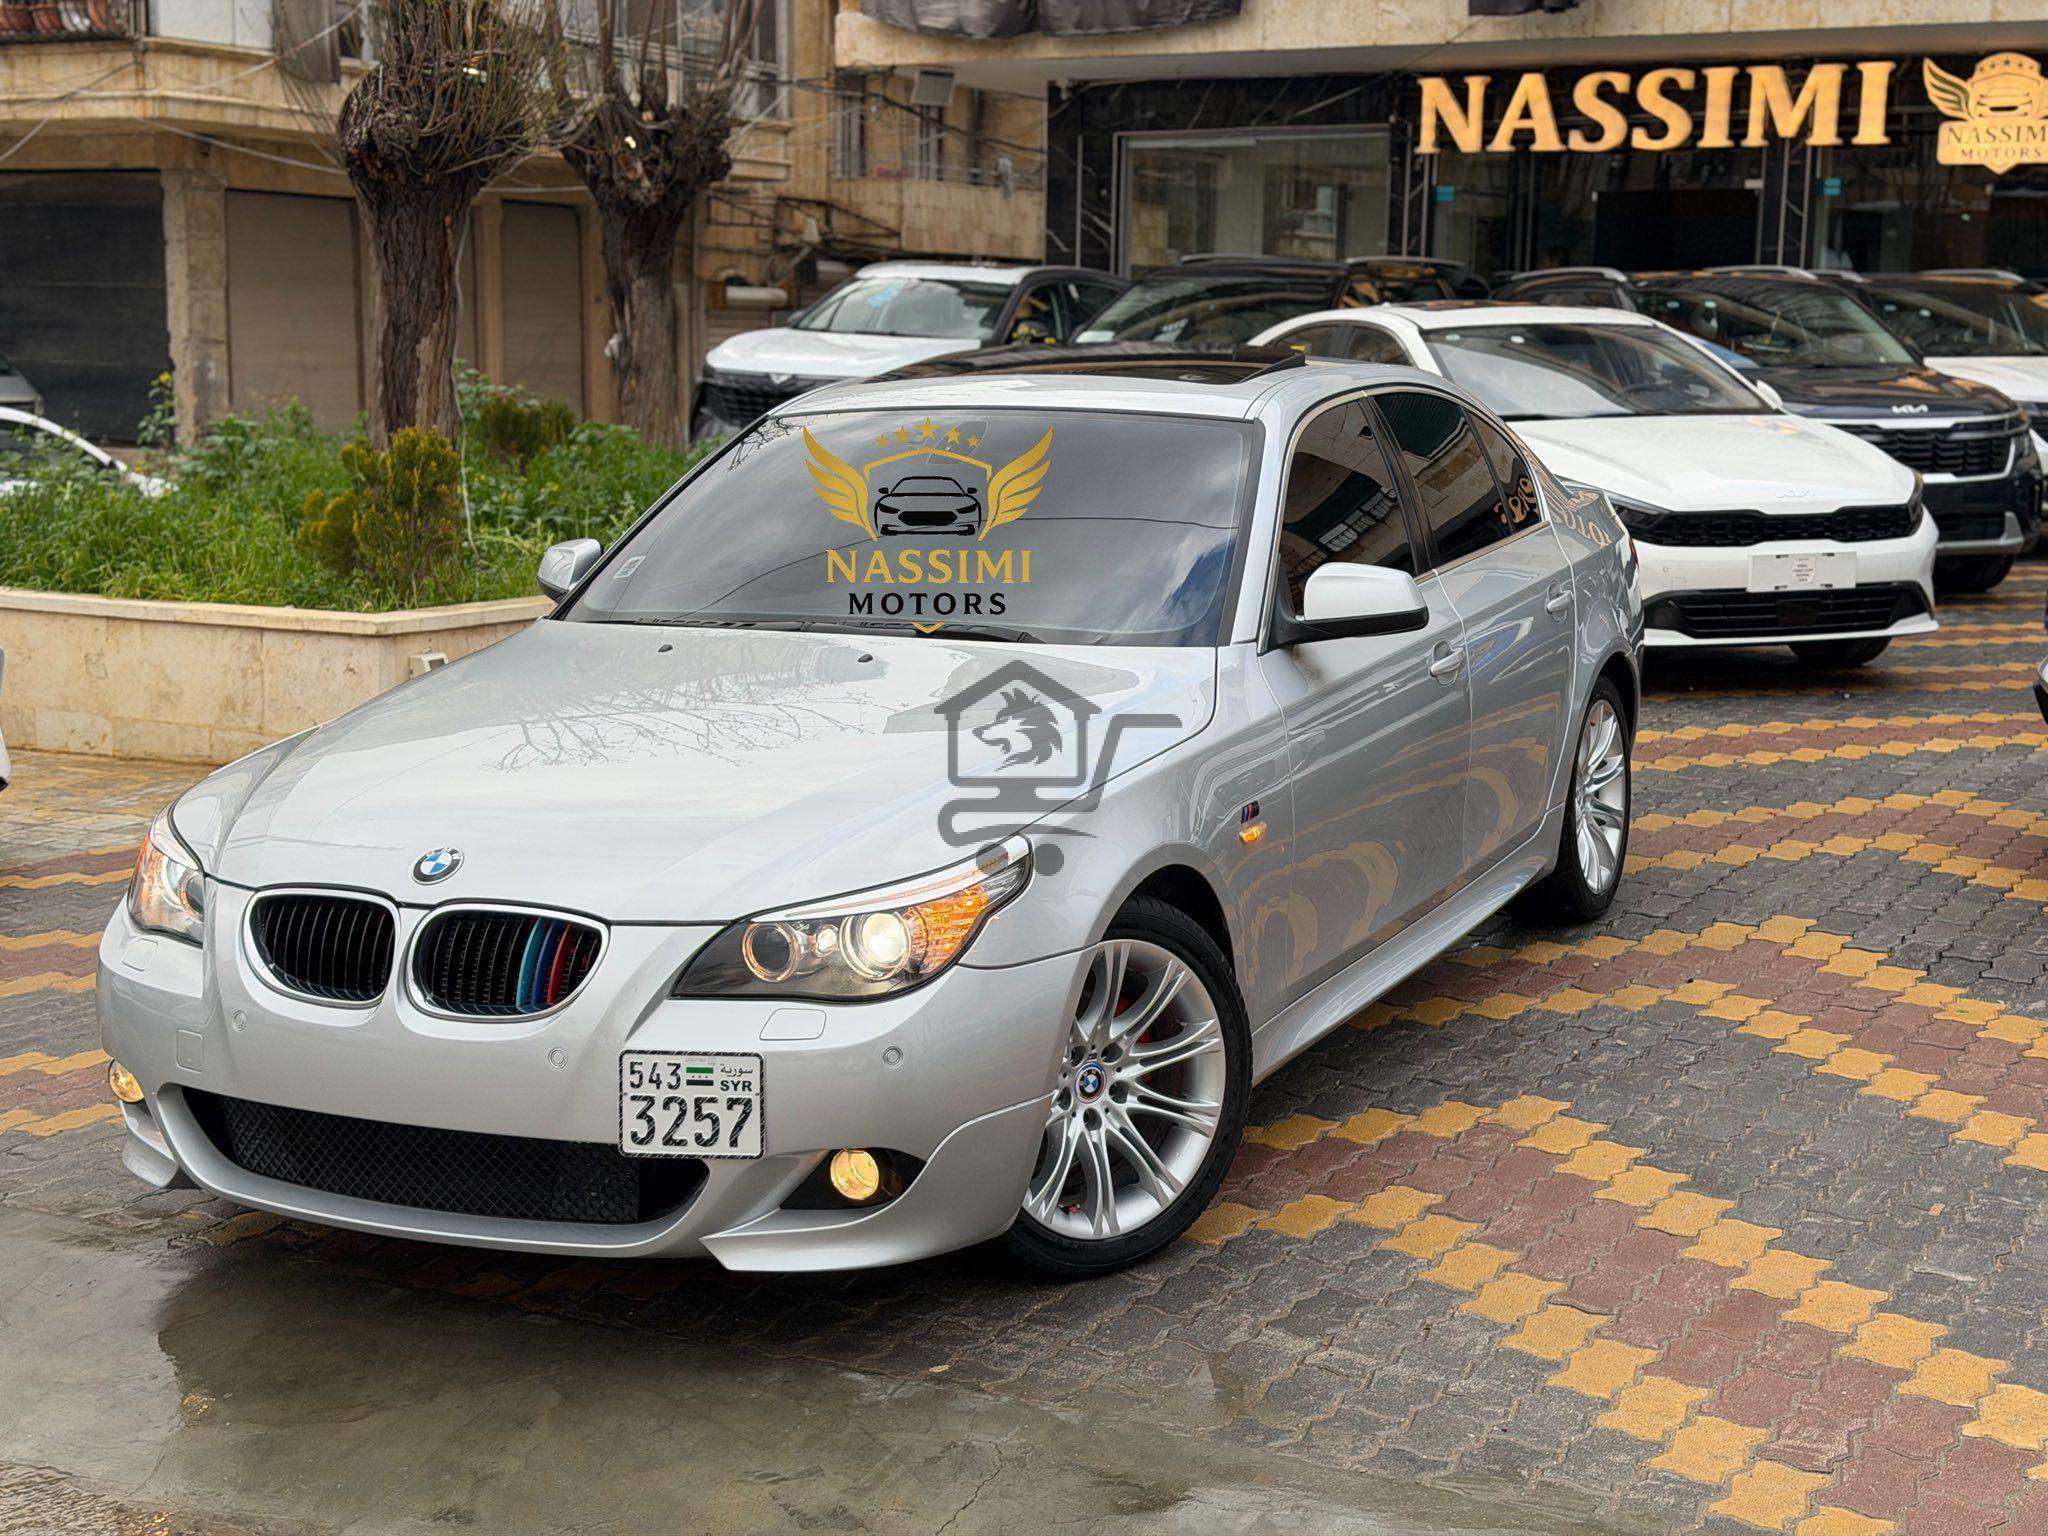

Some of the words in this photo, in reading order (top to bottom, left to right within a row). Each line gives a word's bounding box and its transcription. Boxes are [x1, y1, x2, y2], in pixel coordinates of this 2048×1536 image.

[1414, 61, 1896, 154] NASSIMI
[1947, 125, 2048, 144] NASSIM
[1961, 147, 2042, 159] MOTORS
[629, 1061, 681, 1090] 543
[720, 1063, 753, 1077] سورية
[720, 1080, 753, 1092] SYR
[630, 1095, 753, 1148] 3257
